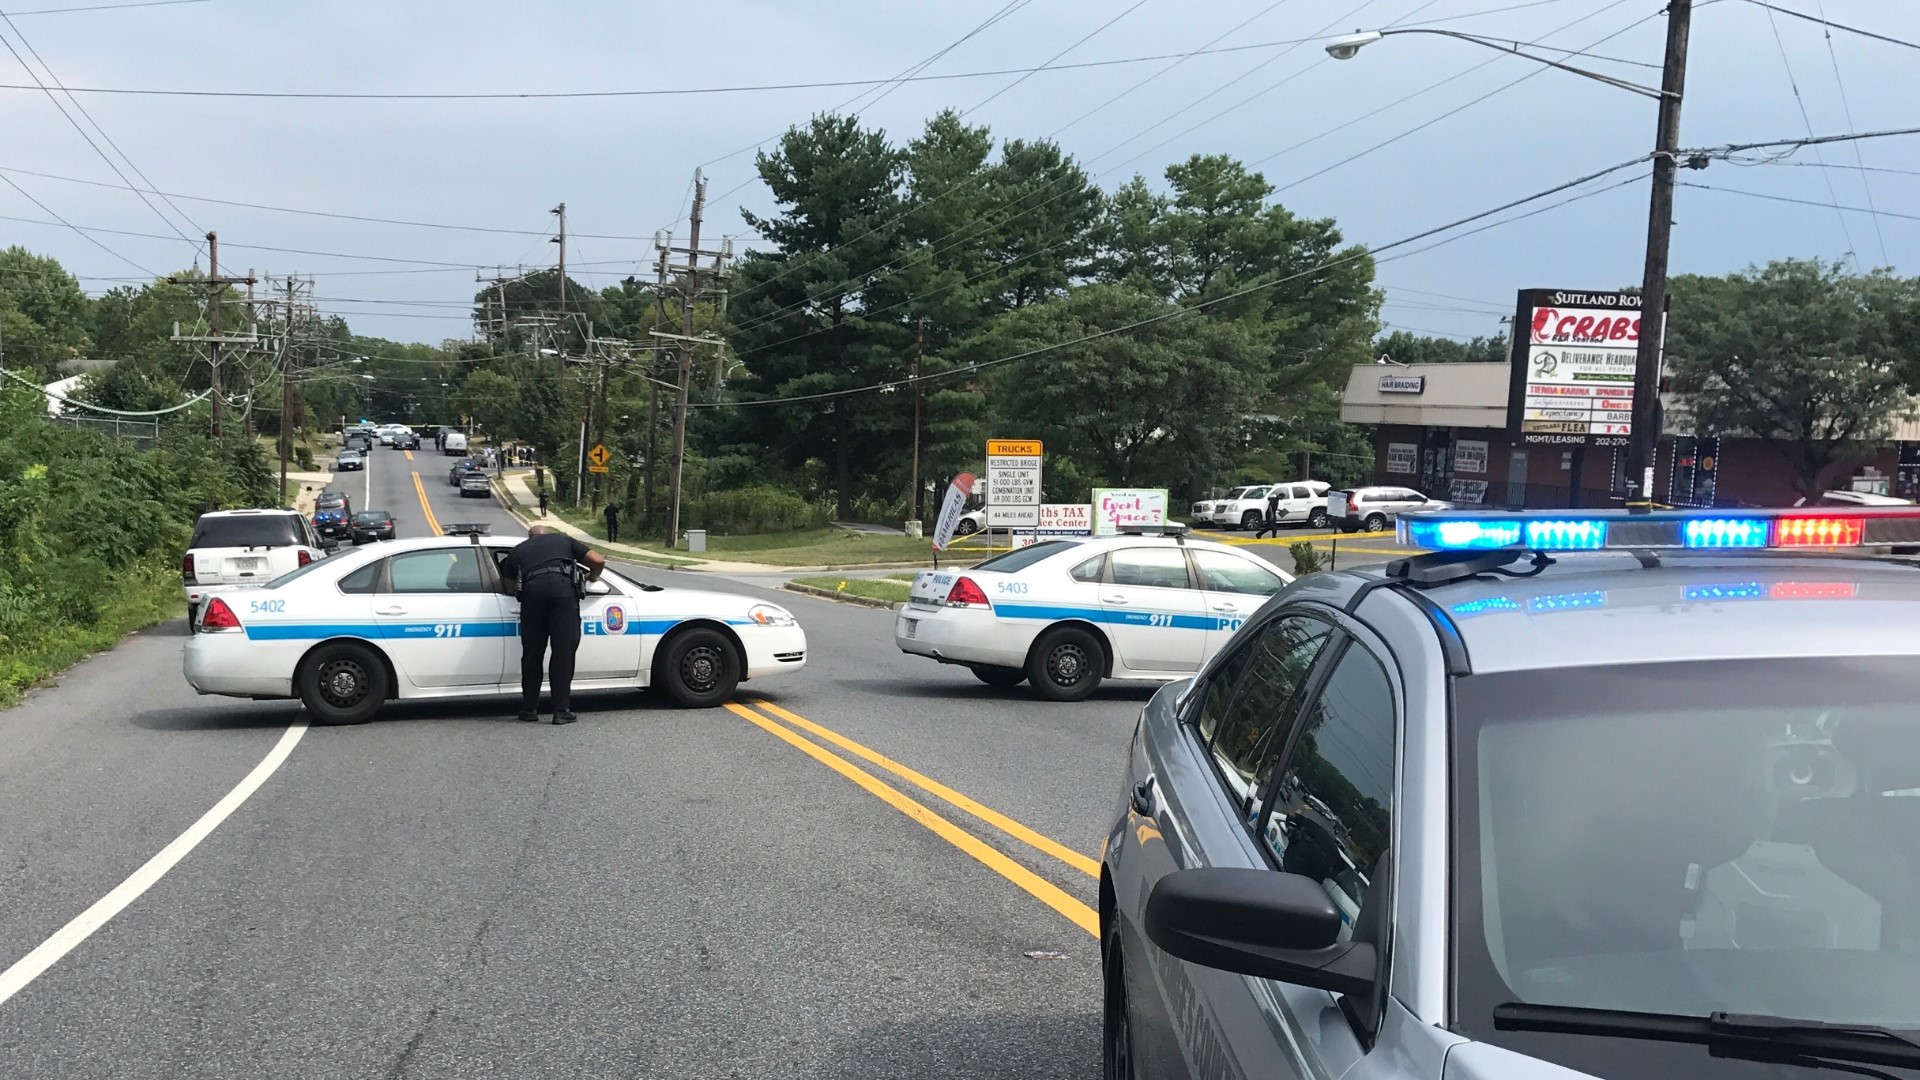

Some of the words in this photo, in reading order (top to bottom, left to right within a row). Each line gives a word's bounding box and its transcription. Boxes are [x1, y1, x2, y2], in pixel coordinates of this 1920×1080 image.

[1554, 291, 1616, 306] SUITLAND
[1561, 351, 1603, 365] DELIVERANCE
[1605, 353, 1636, 367] HEADQUA
[1394, 381, 1419, 389] BRAIDING
[1530, 386, 1558, 395] TIENDA
[1561, 423, 1586, 432] FLEA
[1525, 435, 1586, 444] MGMT/LEASING
[997, 445, 1033, 453] TRUCKS
[990, 459, 1019, 467] RESTRICTED
[1020, 459, 1038, 467] BRIDGE
[991, 487, 1023, 495] COMBINATION
[1024, 487, 1035, 495] UNIT
[1103, 498, 1144, 510] Event
[1041, 507, 1059, 518] th's
[1062, 507, 1085, 518] TAX
[1108, 509, 1149, 527] Space
[1056, 518, 1088, 527] Center
[932, 574, 952, 585] POLICE
[997, 582, 1028, 594] 5403
[250, 600, 285, 613] 5402
[1149, 614, 1173, 627] 911
[434, 624, 462, 637] 911
